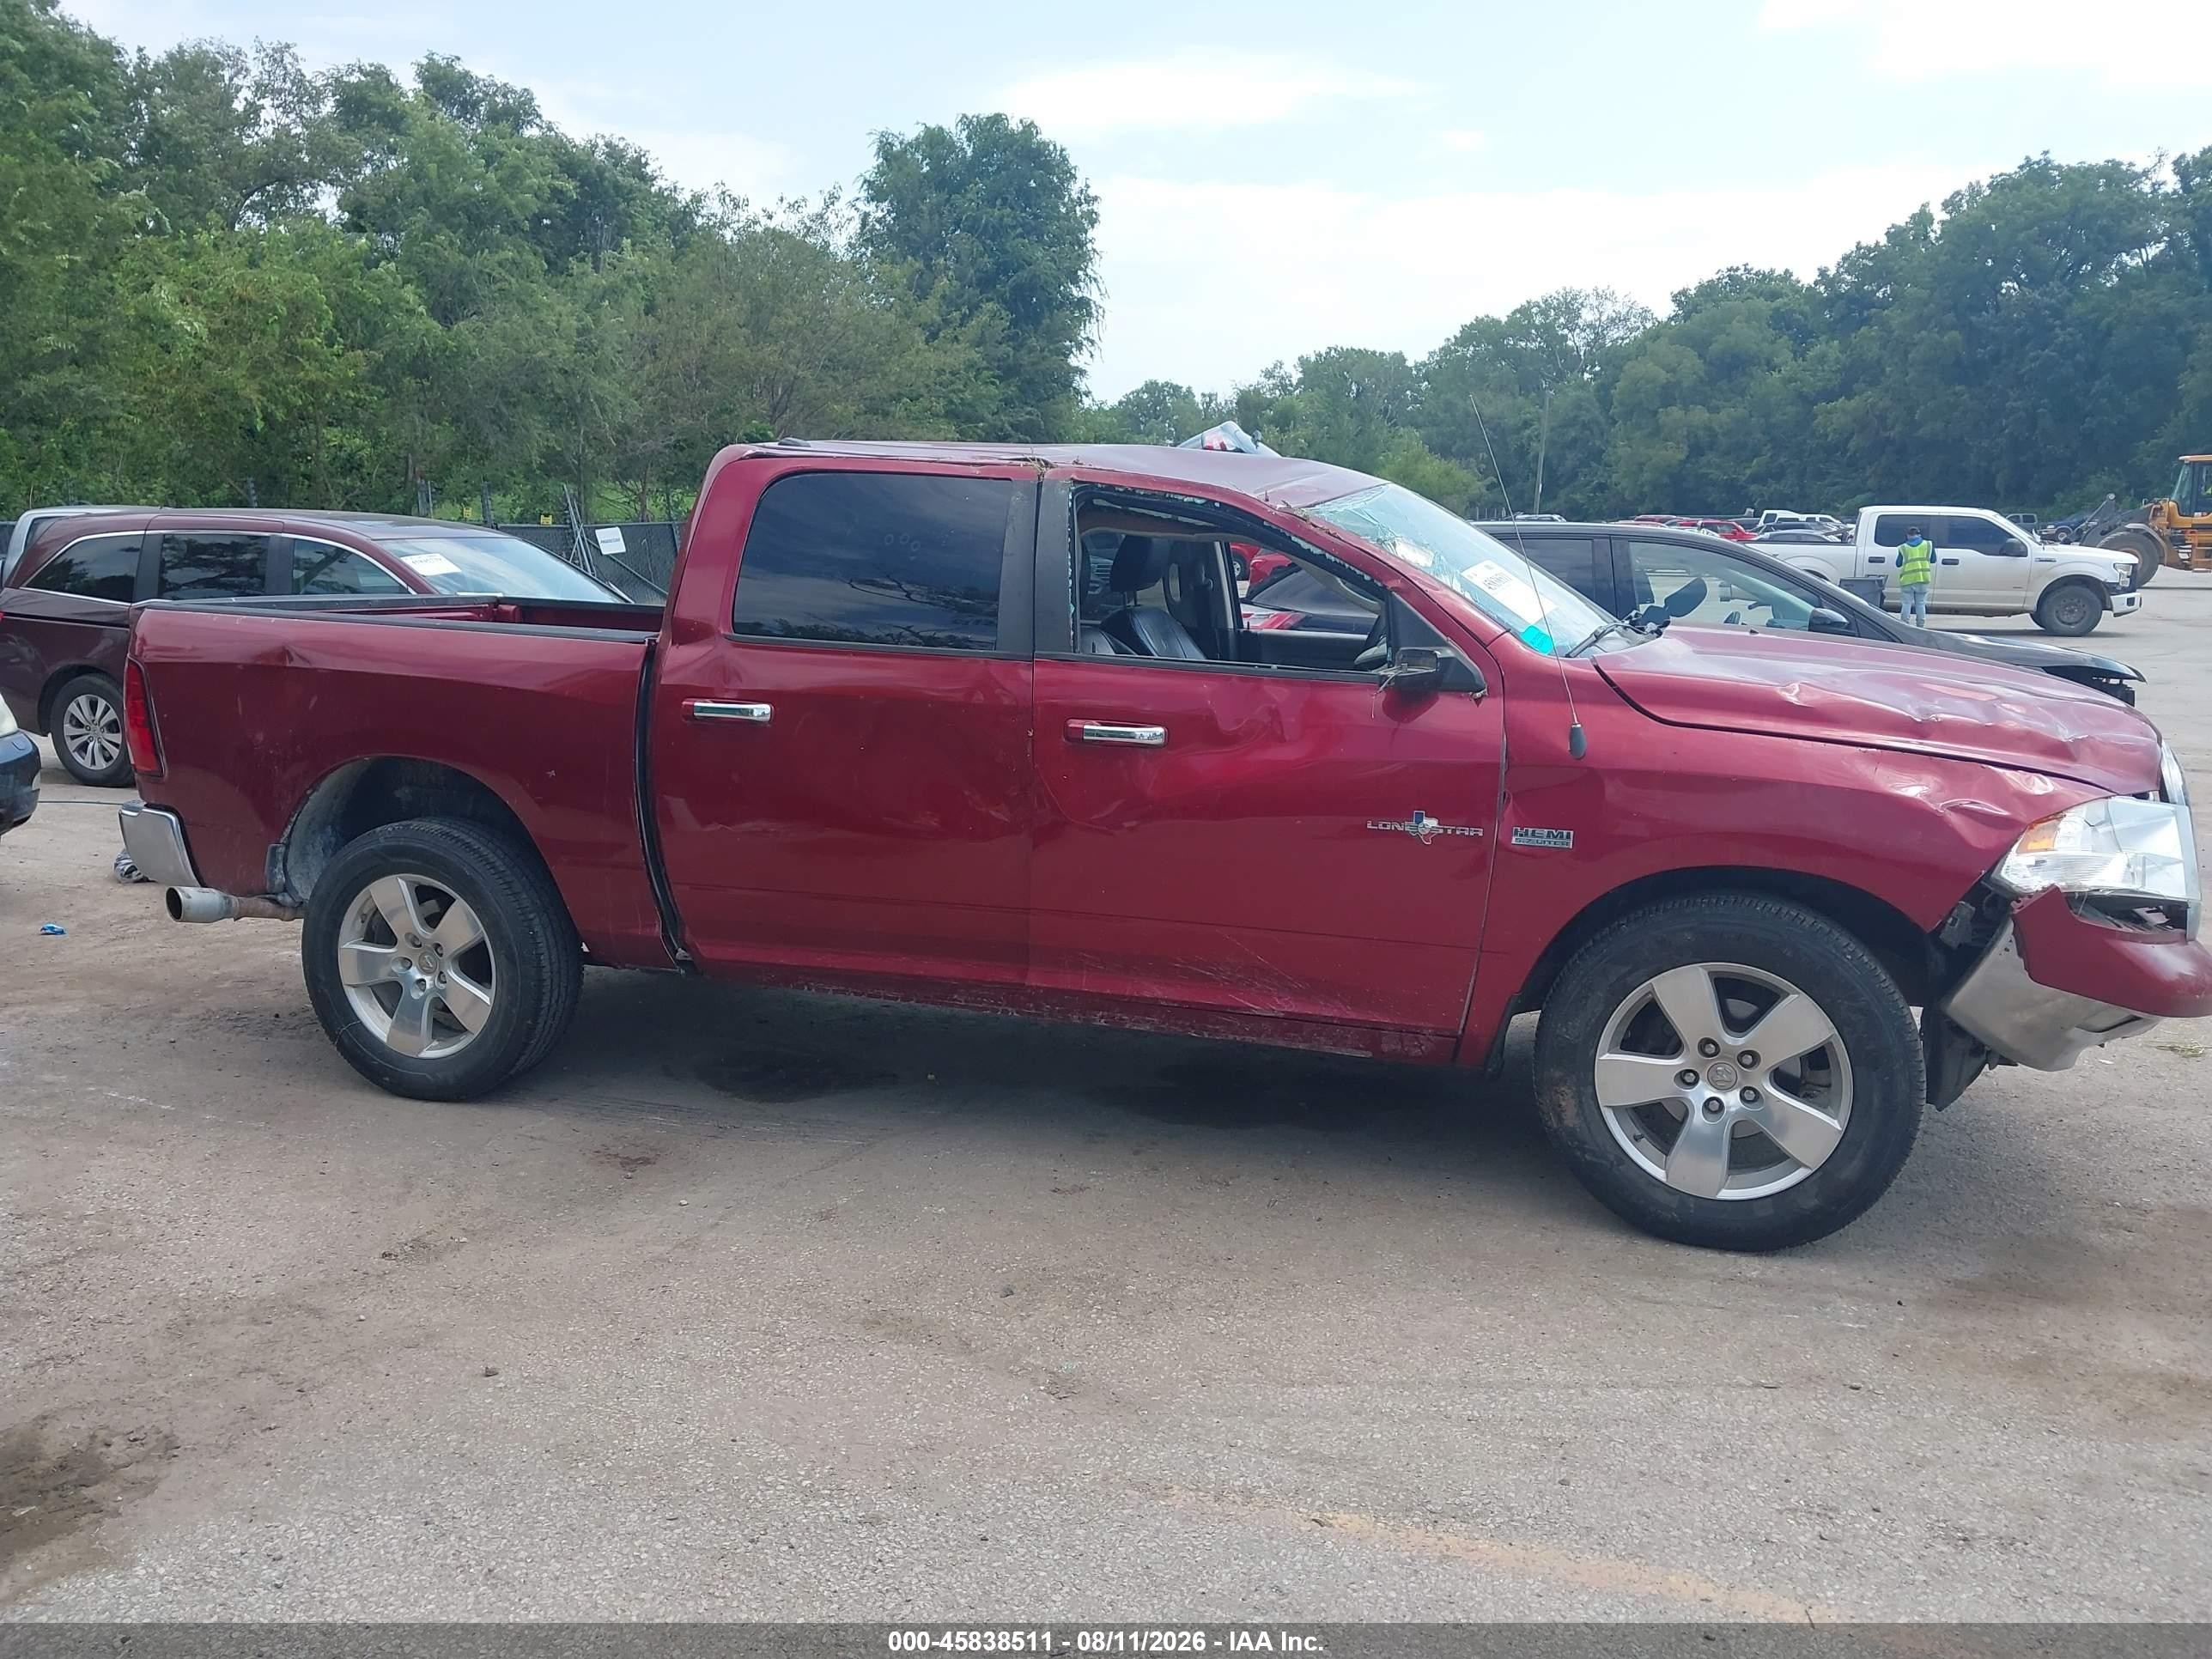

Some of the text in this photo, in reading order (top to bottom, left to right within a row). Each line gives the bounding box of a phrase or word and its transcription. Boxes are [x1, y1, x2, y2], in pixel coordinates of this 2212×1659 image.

[1367, 820, 1484, 836] LONE STAR
[1513, 827, 1573, 841] HEMI
